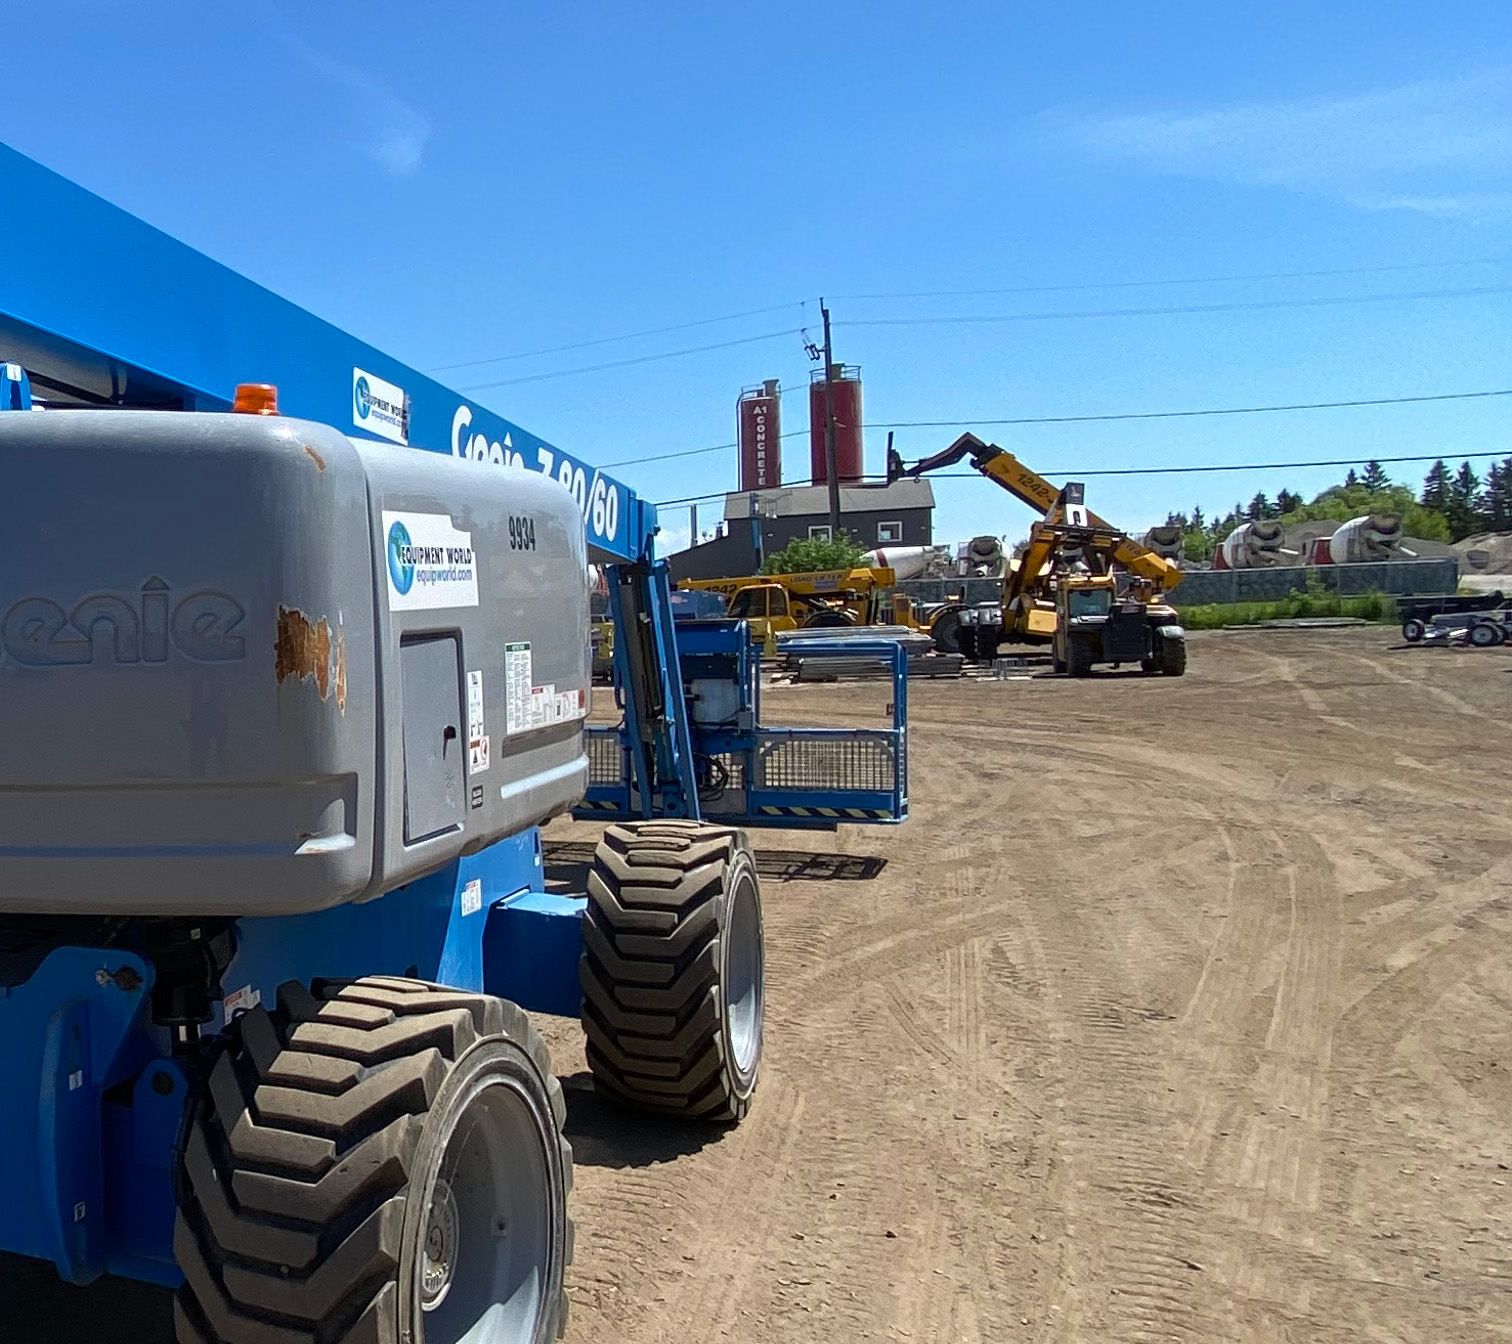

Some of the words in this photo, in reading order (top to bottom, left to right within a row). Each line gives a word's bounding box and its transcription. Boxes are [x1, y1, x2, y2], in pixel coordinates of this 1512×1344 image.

[753, 405, 768, 415] A1
[756, 416, 766, 486] CONCRETE
[508, 515, 536, 551] 9934
[401, 546, 444, 565] EQUIPMENT
[446, 547, 472, 565] WORLD
[416, 567, 473, 586] equipworld.com
